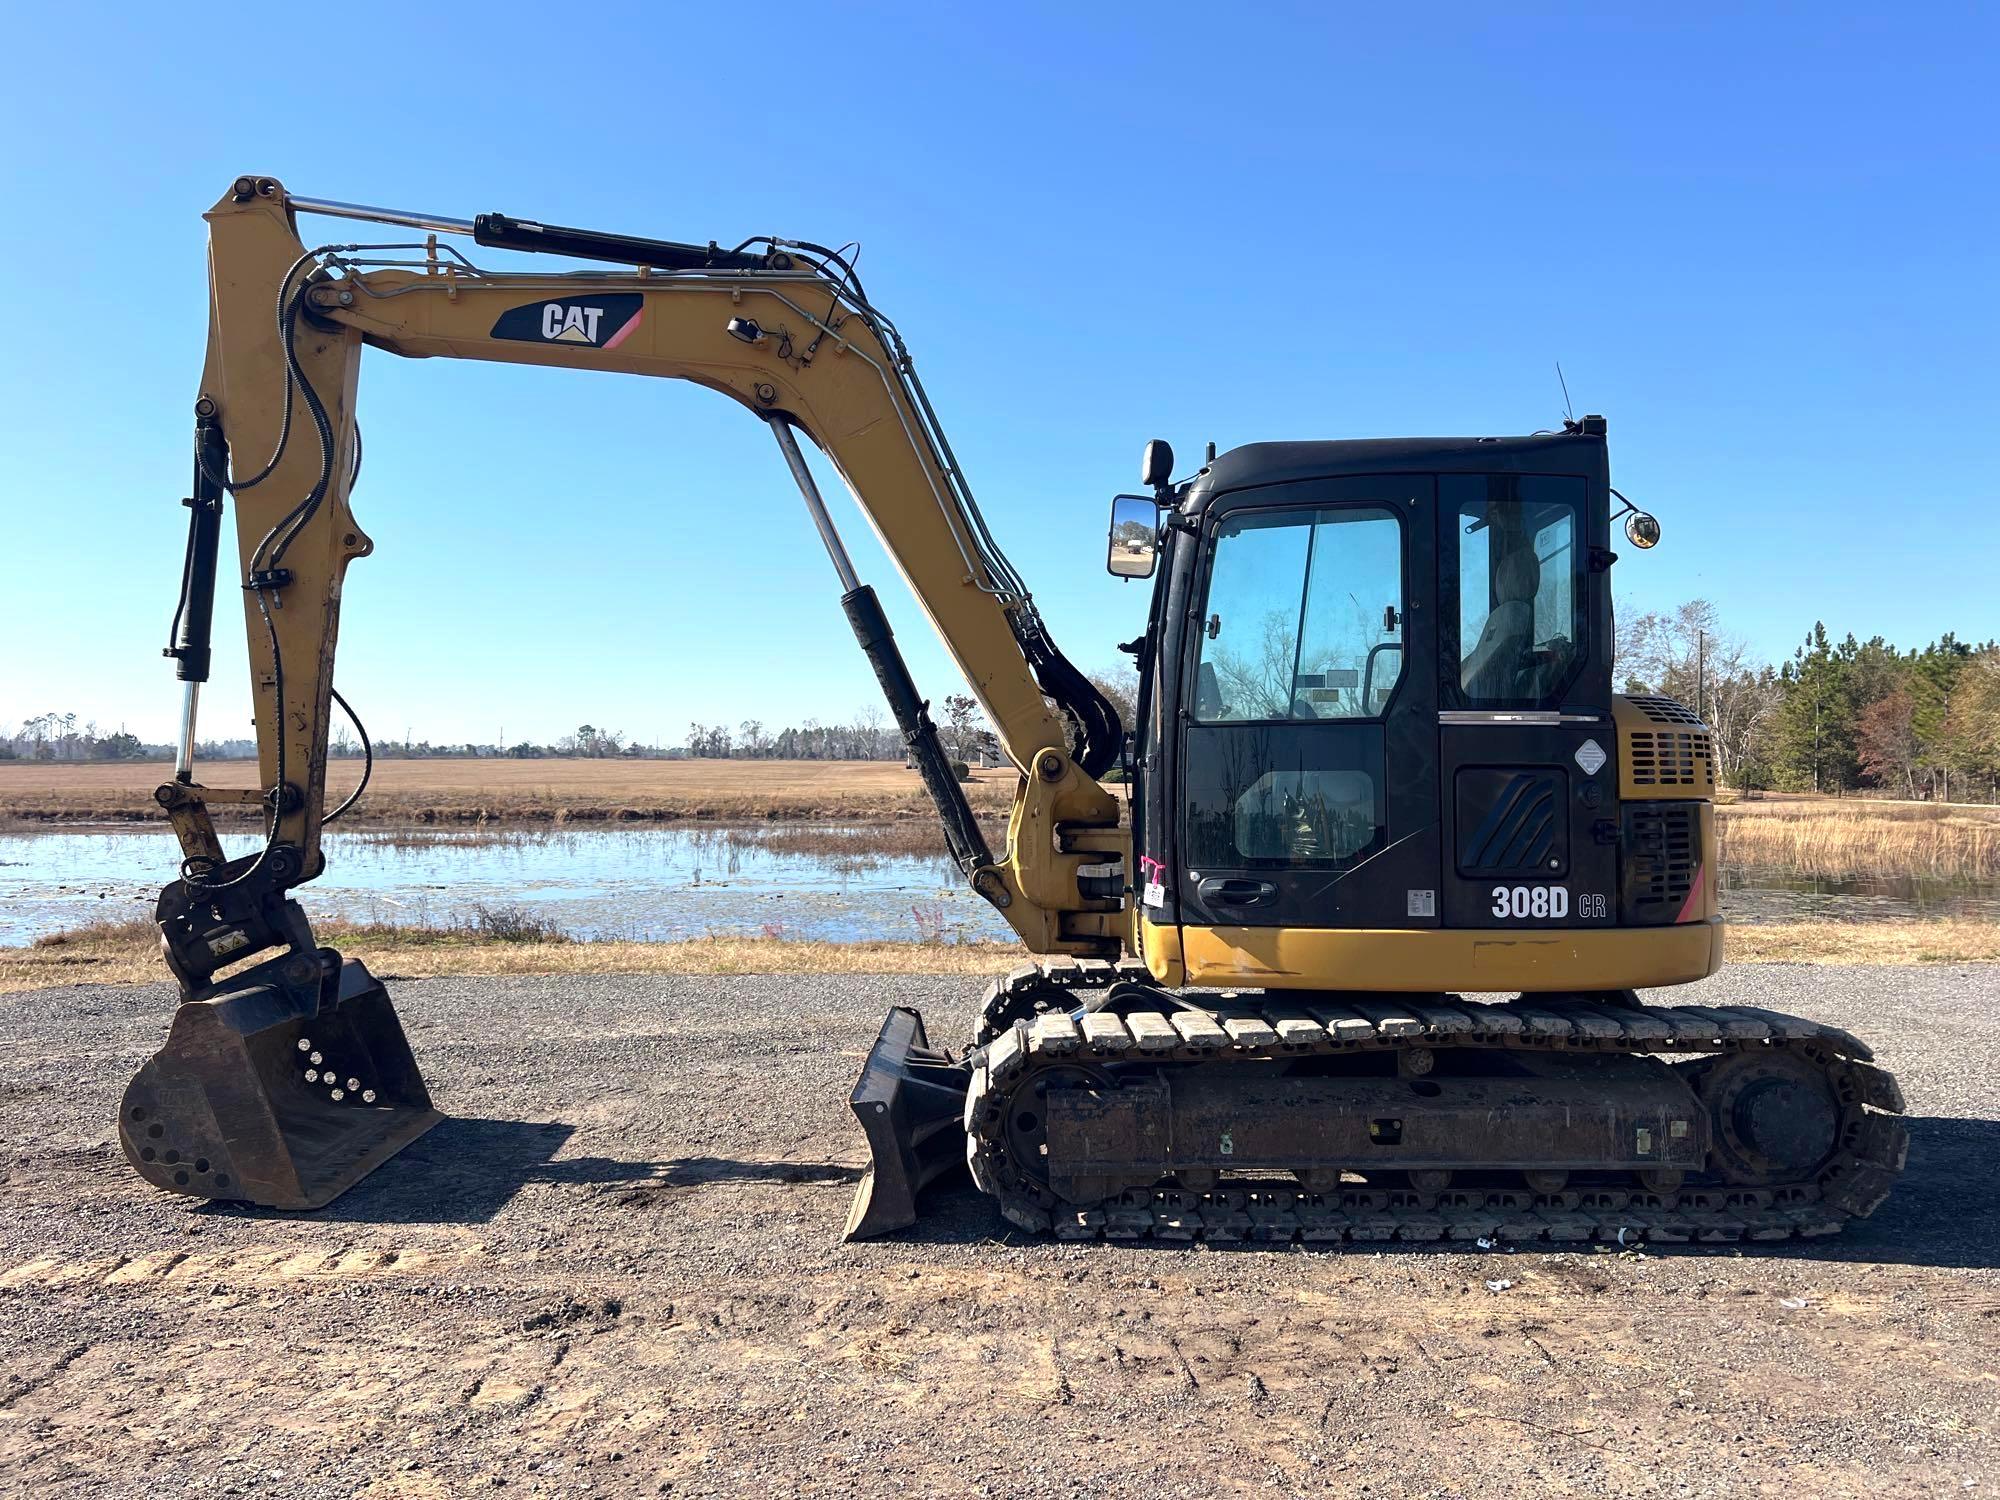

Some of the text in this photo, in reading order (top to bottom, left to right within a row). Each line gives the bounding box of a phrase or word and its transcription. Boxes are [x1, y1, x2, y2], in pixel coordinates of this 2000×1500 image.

[542, 303, 604, 343] CAT
[1491, 886, 1606, 918] 308D CR
